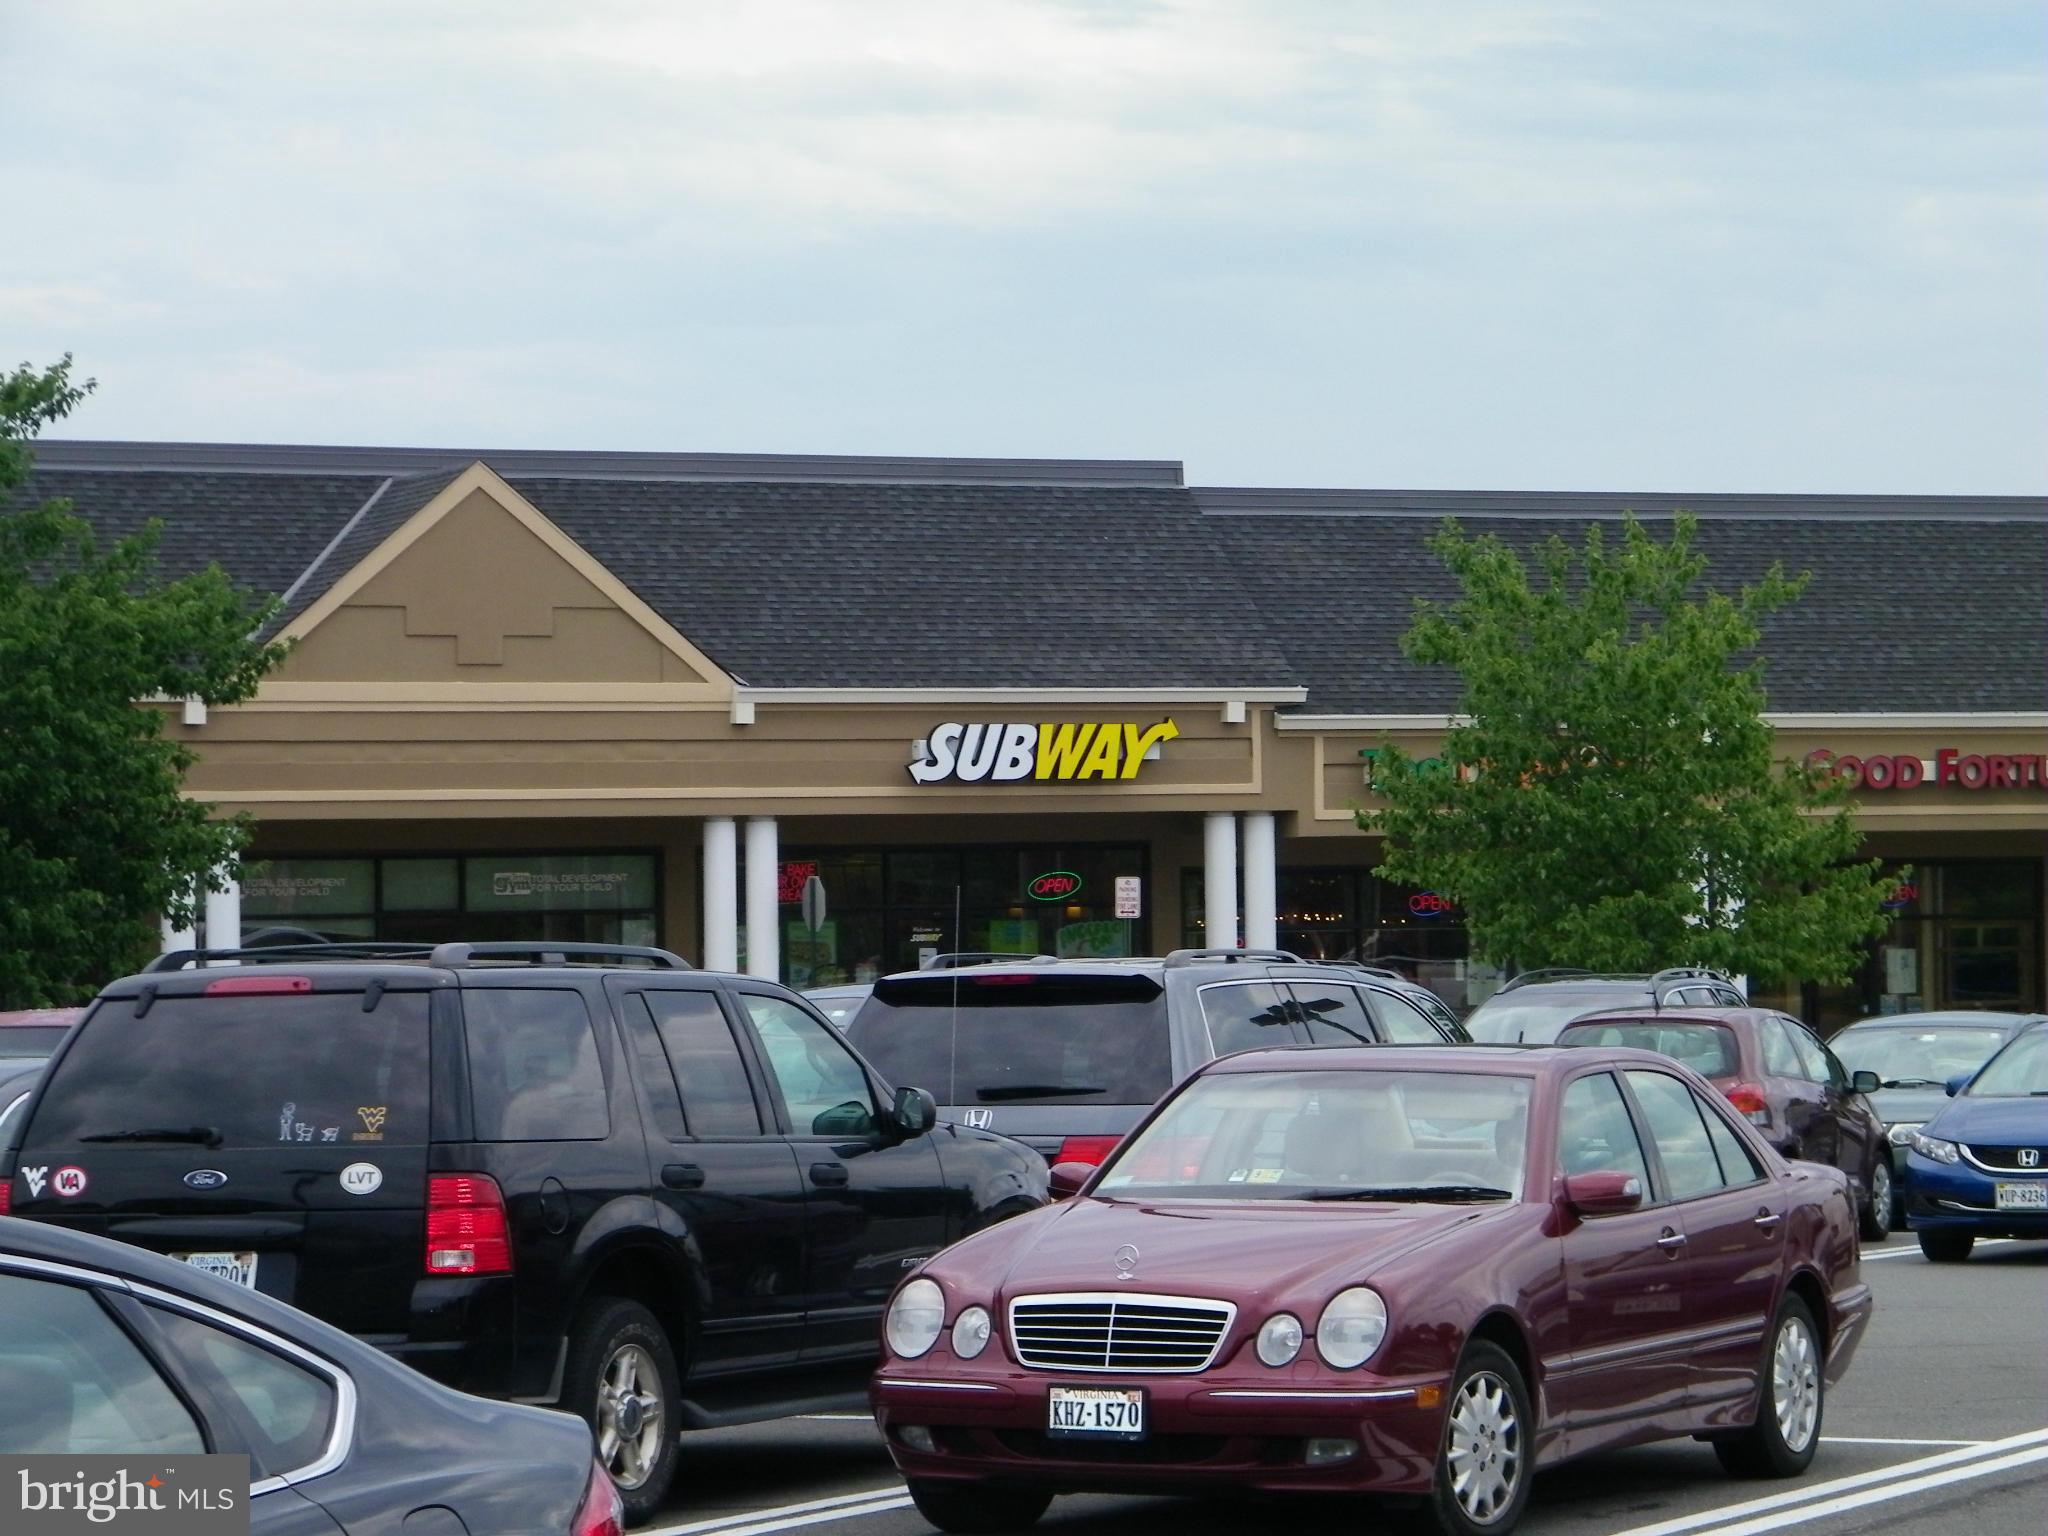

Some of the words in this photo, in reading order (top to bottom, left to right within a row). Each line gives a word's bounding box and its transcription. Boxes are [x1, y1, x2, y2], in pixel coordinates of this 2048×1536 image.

[909, 718, 1179, 784] SUBWAY
[1034, 878, 1074, 893] OPEN
[348, 1171, 376, 1184] LVT
[190, 1255, 233, 1265] VIRGINIA
[1071, 1390, 1119, 1400] VIRGINIA
[1052, 1400, 1140, 1428] KHZ-1570
